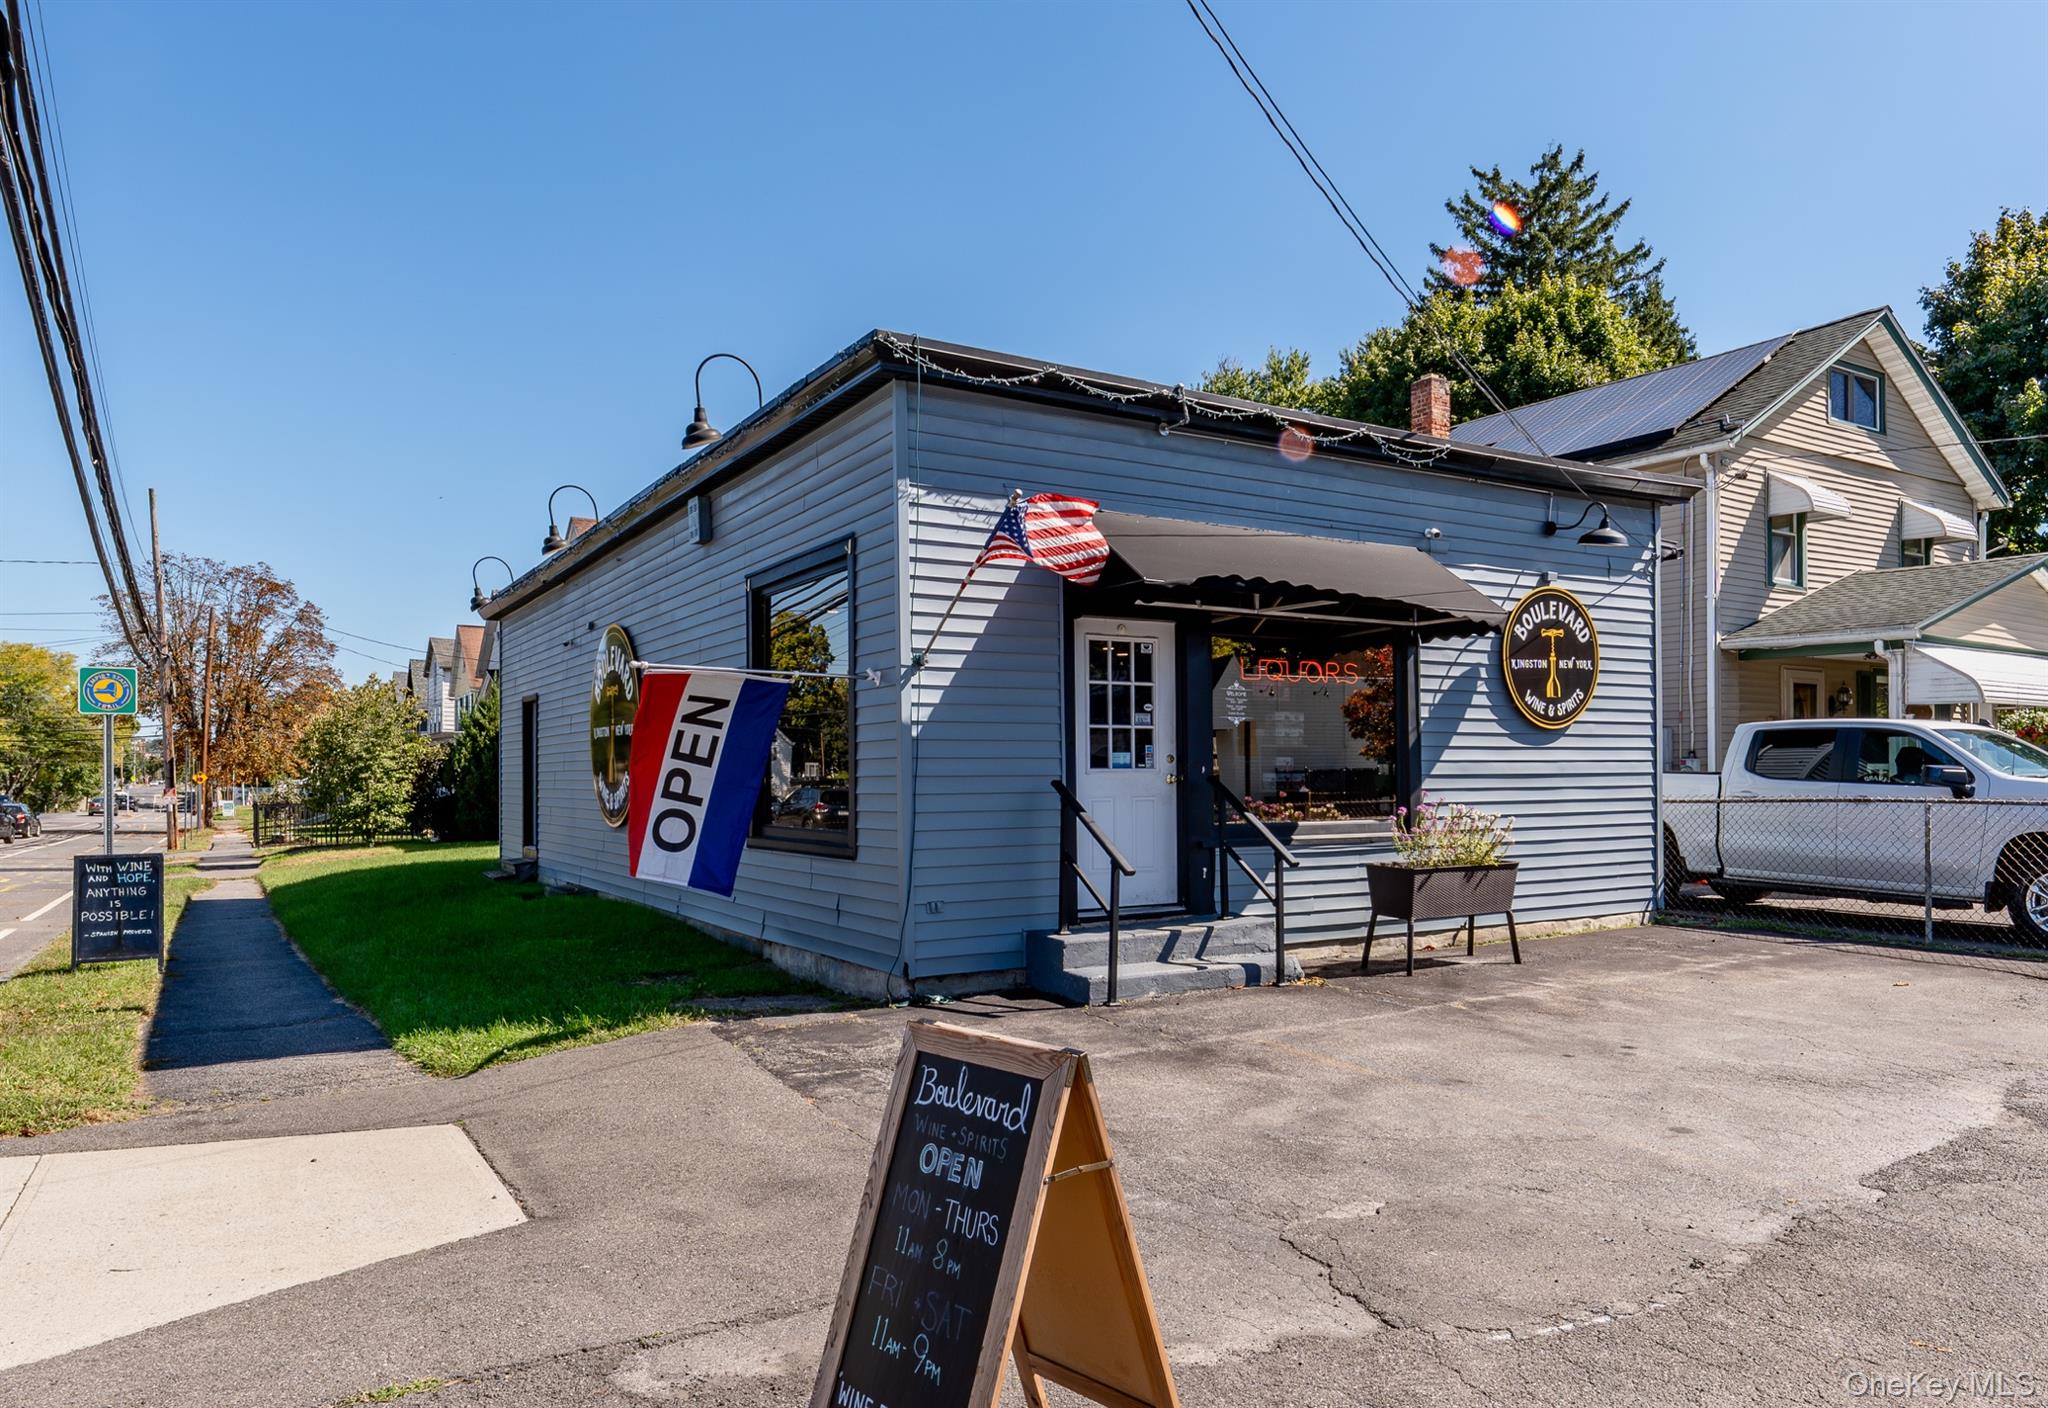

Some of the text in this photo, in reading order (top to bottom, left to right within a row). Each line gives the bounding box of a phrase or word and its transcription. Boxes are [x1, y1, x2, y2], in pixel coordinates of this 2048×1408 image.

[1514, 601, 1590, 643] BOULEVARD
[595, 646, 633, 704] BOULEVARD
[1239, 656, 1360, 685] LIQUORS
[1511, 657, 1593, 671] KINGSTON NEW YORK
[1524, 688, 1584, 717] WINE & SPIRITS
[652, 695, 731, 853] OPEN
[85, 861, 153, 873] WITH WINE
[88, 875, 108, 883] AND
[86, 886, 147, 898] ANYTHING
[110, 900, 121, 908] IS
[81, 910, 154, 922] POSSIBLE!
[914, 1064, 1032, 1135] Boulevard
[915, 1113, 947, 1139] WINE
[958, 1126, 1008, 1160] SPIRITS
[919, 1142, 984, 1190] OPEN
[892, 1182, 931, 1219] MON
[868, 1265, 904, 1309] FRI
